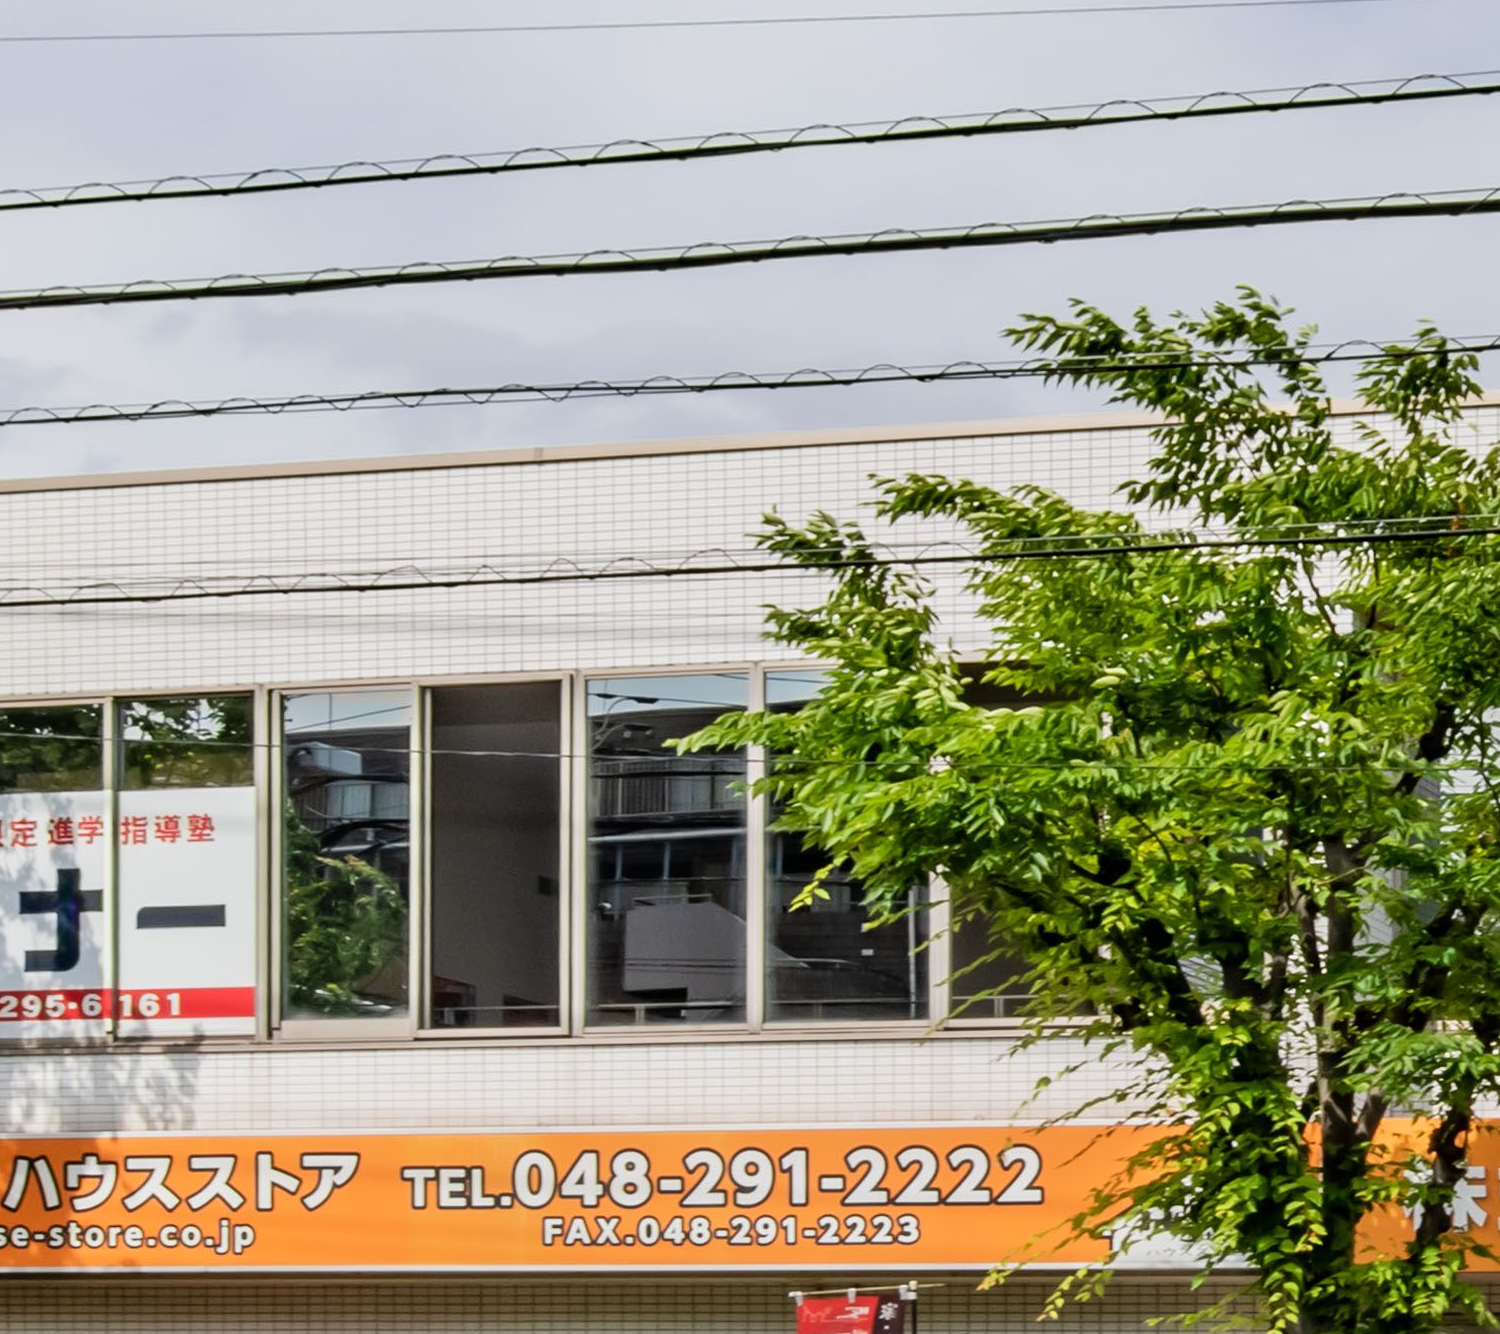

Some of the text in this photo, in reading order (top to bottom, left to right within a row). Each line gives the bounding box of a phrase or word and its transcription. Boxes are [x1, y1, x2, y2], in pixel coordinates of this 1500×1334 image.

[1, 1151, 359, 1214] ハウスストア
[541, 1214, 921, 1246] FAX.048-291-2223
